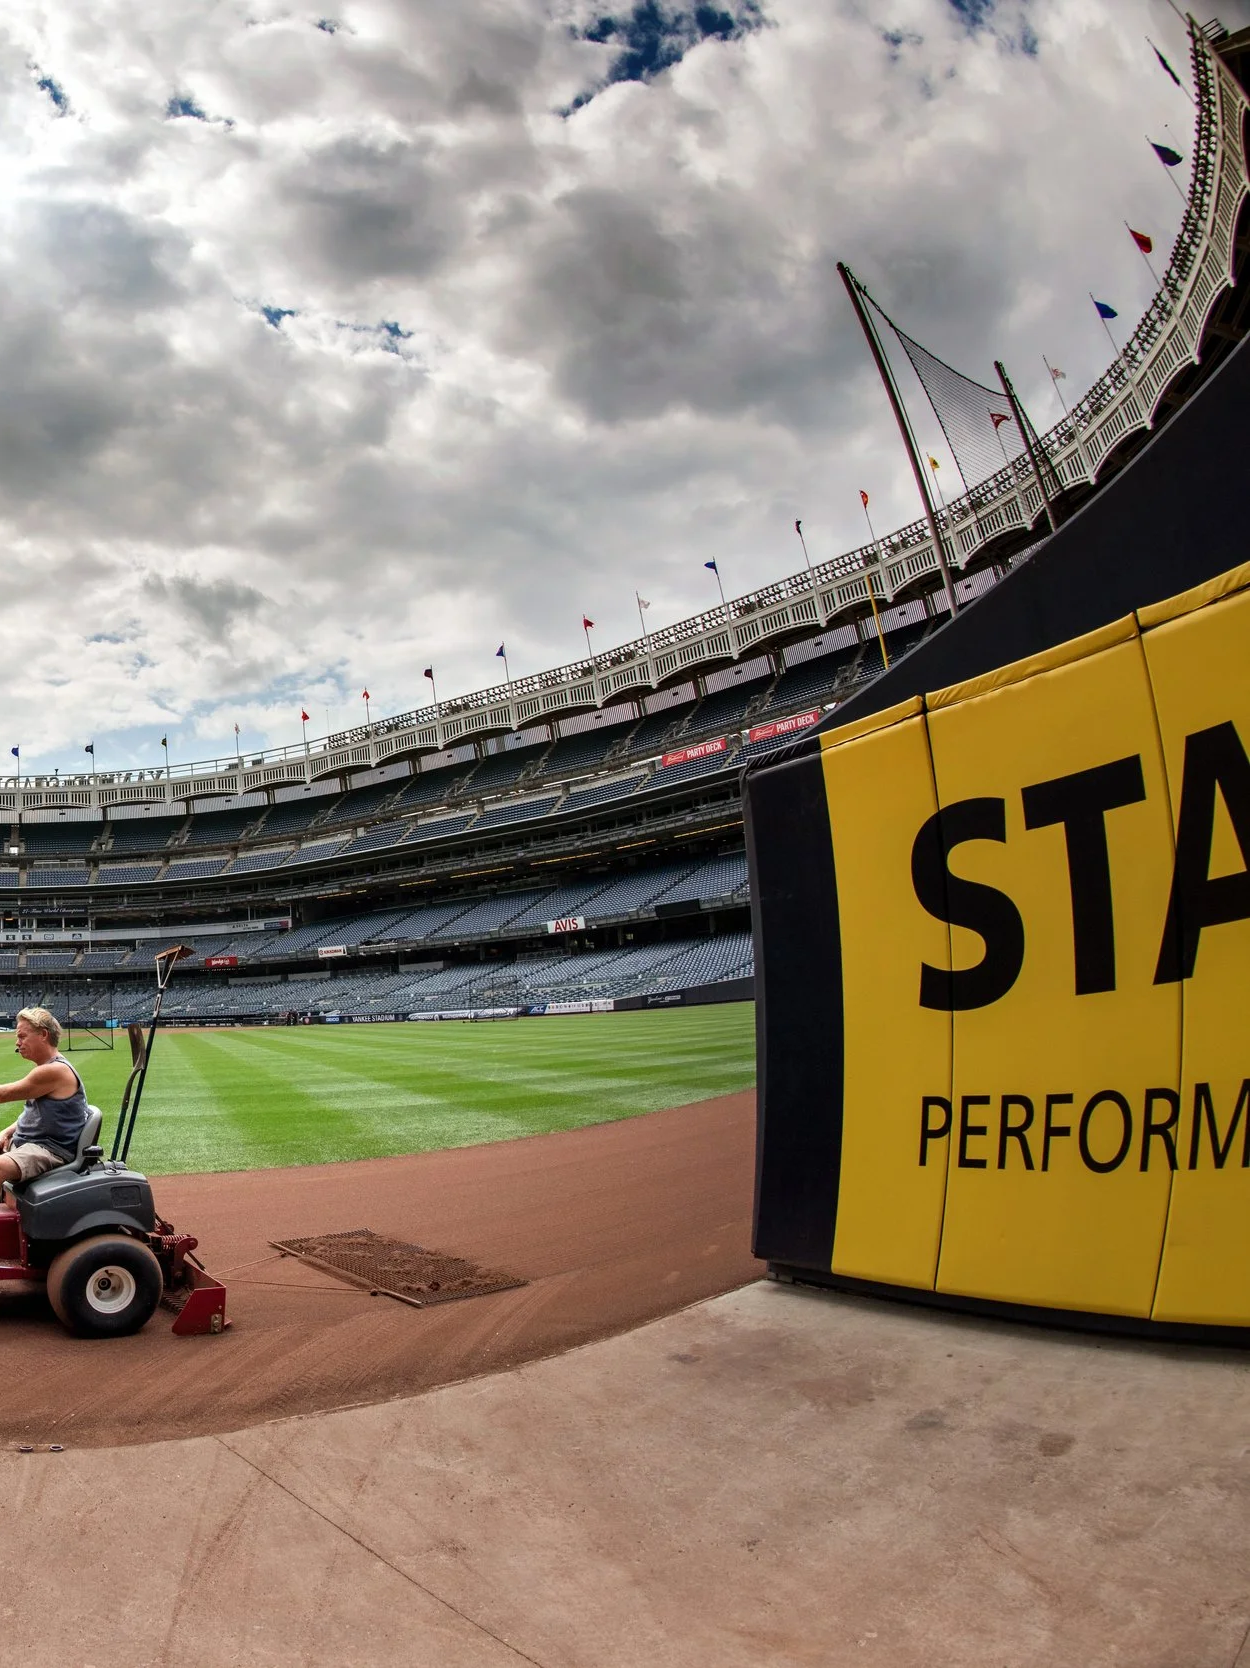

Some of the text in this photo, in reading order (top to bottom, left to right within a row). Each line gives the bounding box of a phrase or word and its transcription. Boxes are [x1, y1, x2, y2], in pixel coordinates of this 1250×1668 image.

[776, 718, 796, 732] PARTY
[797, 713, 815, 726] DECK
[686, 746, 705, 759] PARTY
[705, 742, 723, 754] DECK
[911, 719, 1250, 1012] STA
[554, 918, 579, 932] AVIS
[918, 1078, 1250, 1173] PERFORM
